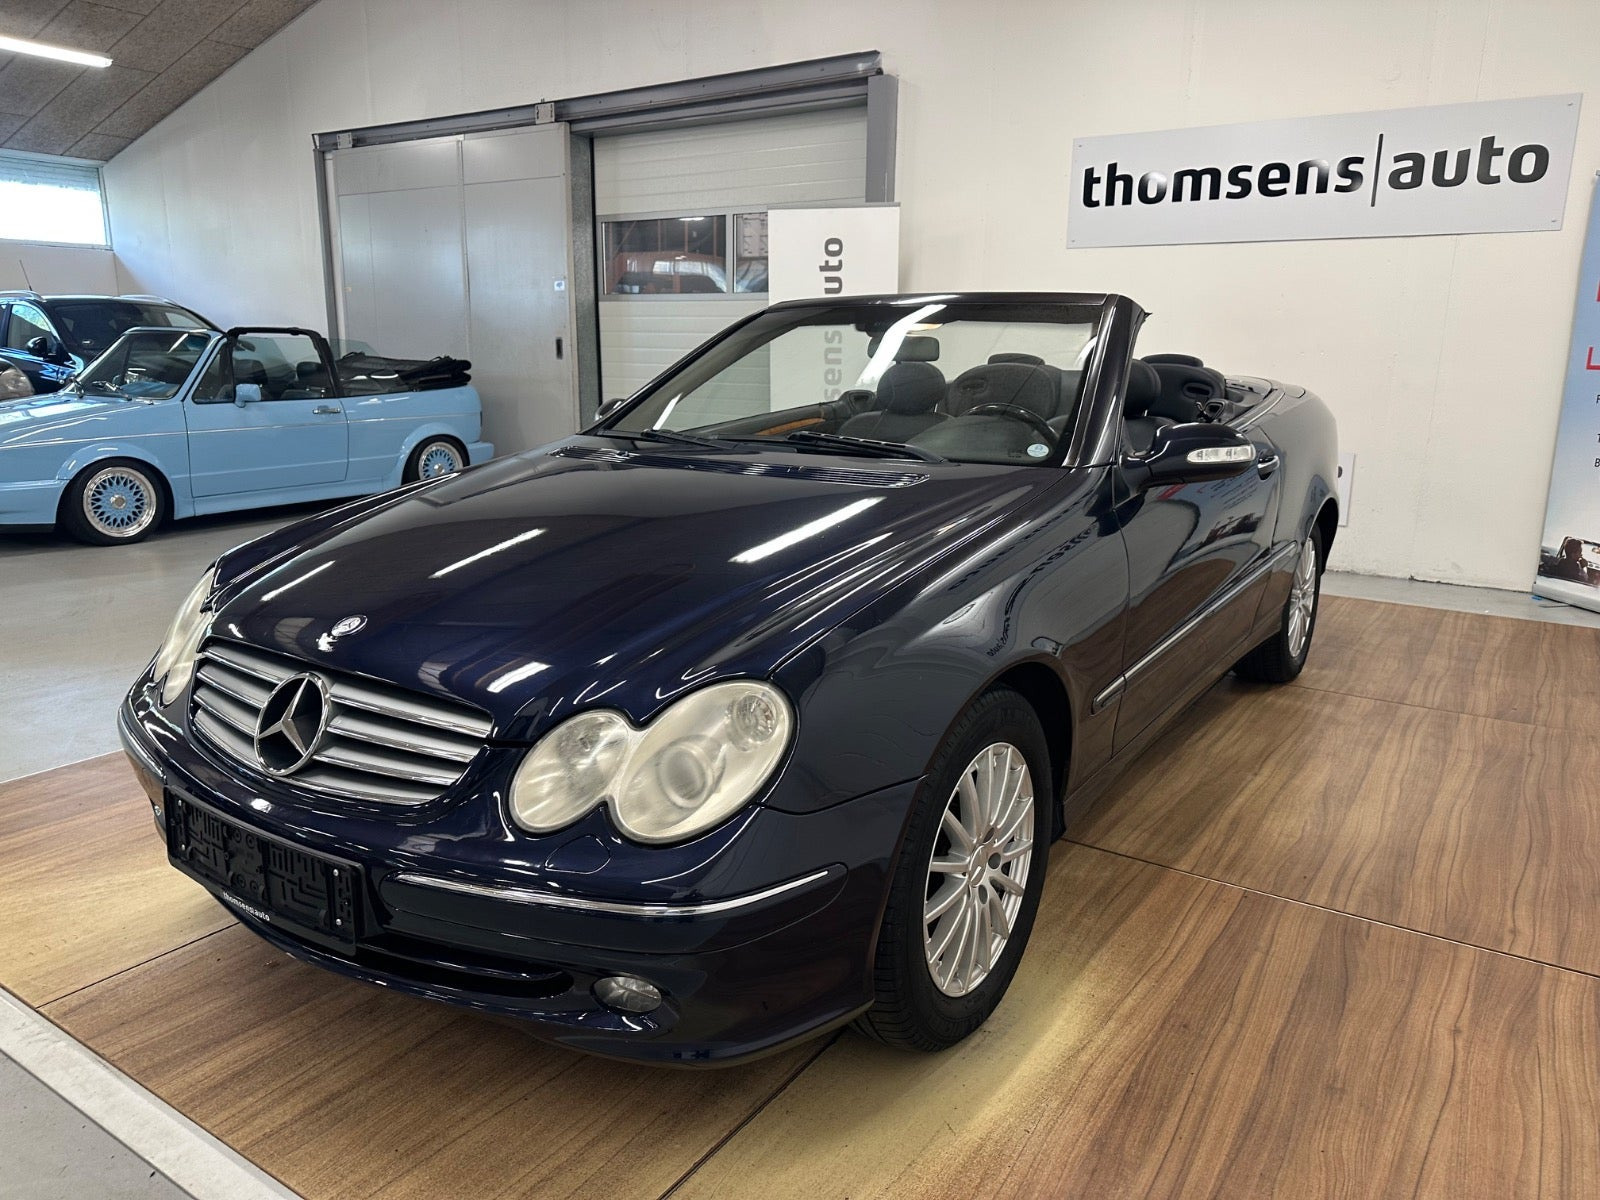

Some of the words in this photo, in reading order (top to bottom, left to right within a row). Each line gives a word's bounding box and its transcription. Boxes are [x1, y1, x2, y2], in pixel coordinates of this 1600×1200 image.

[1082, 155, 1365, 208] thomsens
[1388, 135, 1550, 190] auto
[818, 237, 844, 295] uto
[823, 329, 843, 402] sens
